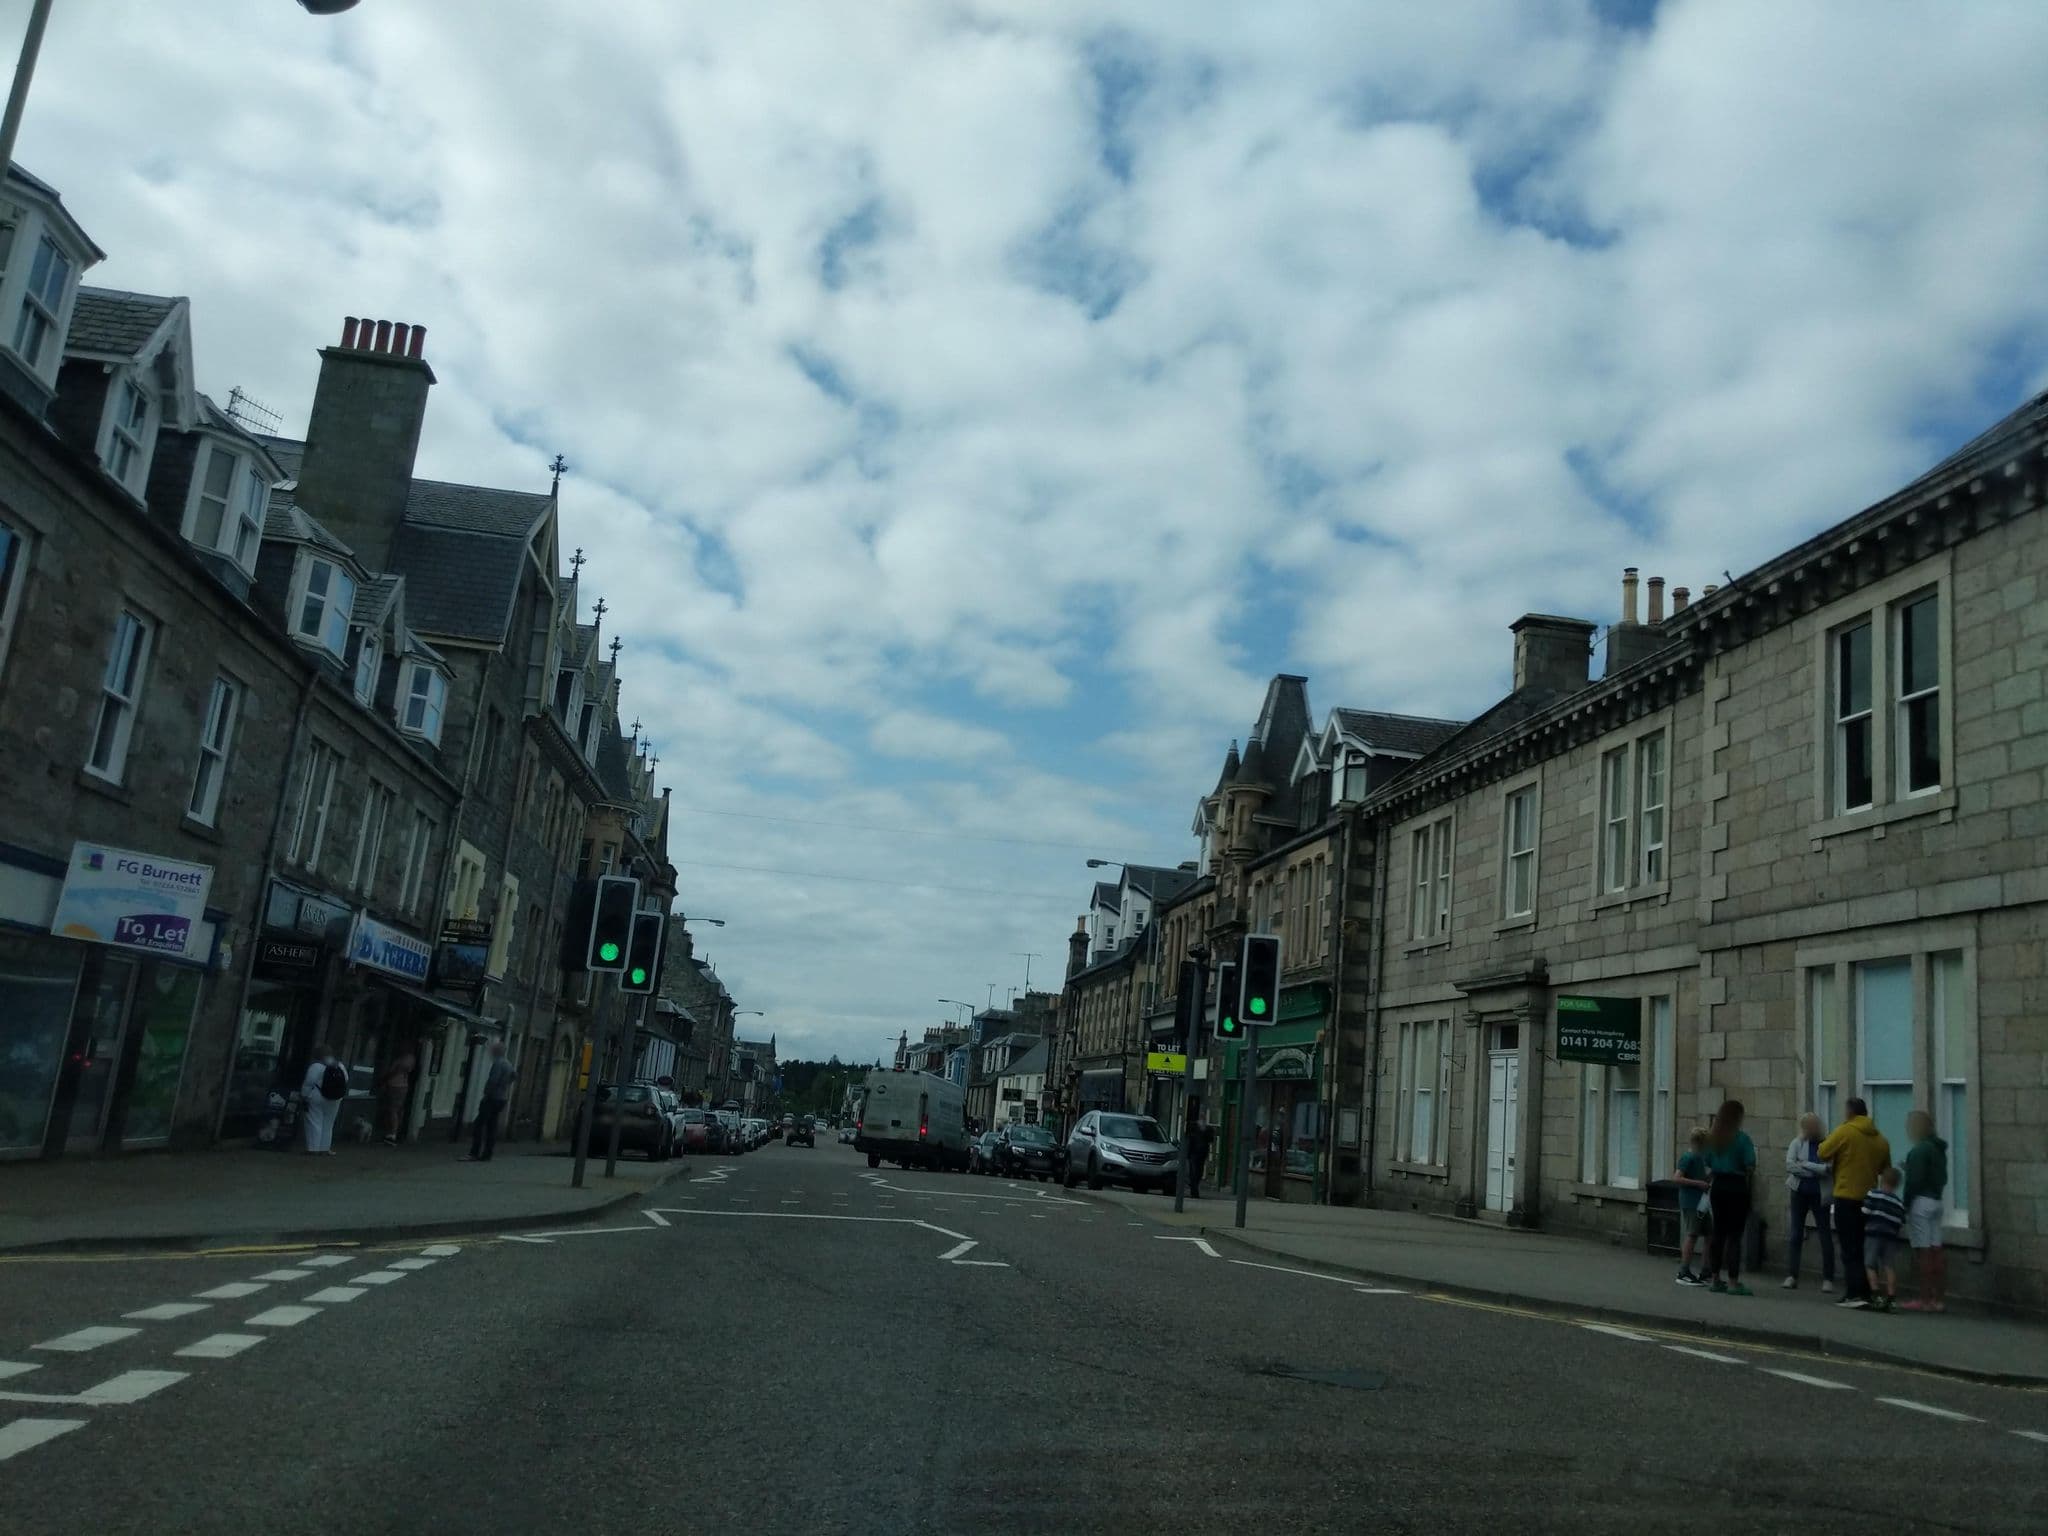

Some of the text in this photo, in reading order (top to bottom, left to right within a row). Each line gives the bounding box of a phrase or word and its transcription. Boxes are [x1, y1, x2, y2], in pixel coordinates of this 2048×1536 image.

[117, 859, 202, 886] FG Burnett
[122, 918, 186, 943] To Let
[1561, 1036, 1588, 1047] 0141
[1592, 1038, 1614, 1049] 204
